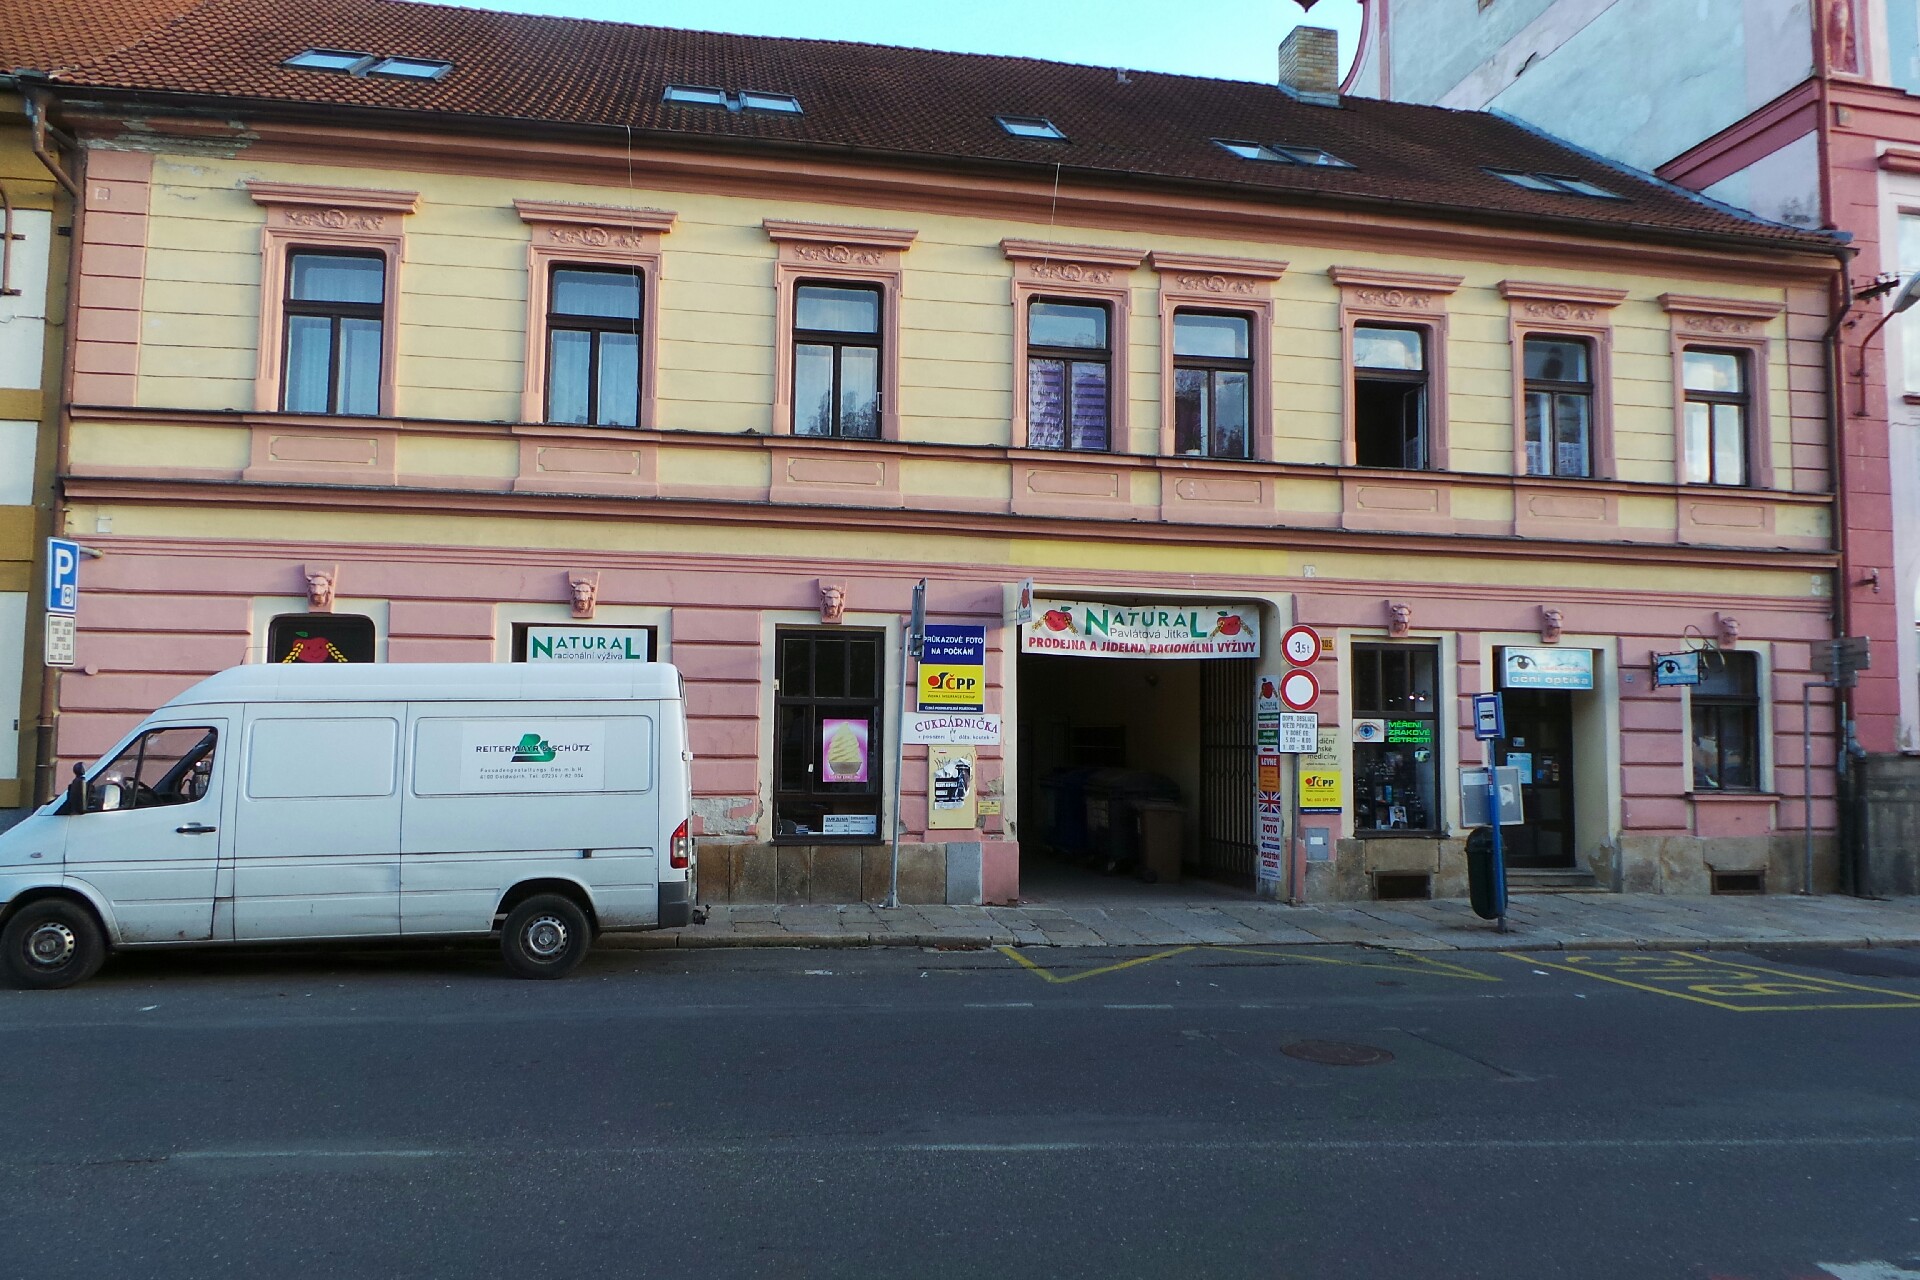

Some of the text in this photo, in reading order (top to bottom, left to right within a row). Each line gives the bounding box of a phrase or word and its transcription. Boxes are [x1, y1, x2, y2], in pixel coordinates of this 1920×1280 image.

[55, 548, 74, 588] P
[1085, 607, 1207, 638] NATURAL
[1110, 628, 1189, 639] Pavlátová Jitka
[965, 636, 984, 644] FOTO
[1028, 637, 1256, 653] PRODEJNA A JÍDELNA RACIONÁLNÍ VÝŽIVY
[532, 635, 640, 659] NATURAL
[943, 647, 974, 656] POČKÁNÍ
[554, 651, 622, 661] racionální výživa
[946, 674, 976, 690] ČPP
[1545, 675, 1588, 686] optika
[915, 715, 999, 733] CUKRÁRNIČKA
[552, 744, 590, 752] SCHÜTZ
[1316, 777, 1334, 787] ČPP
[1263, 824, 1278, 834] FOTO
